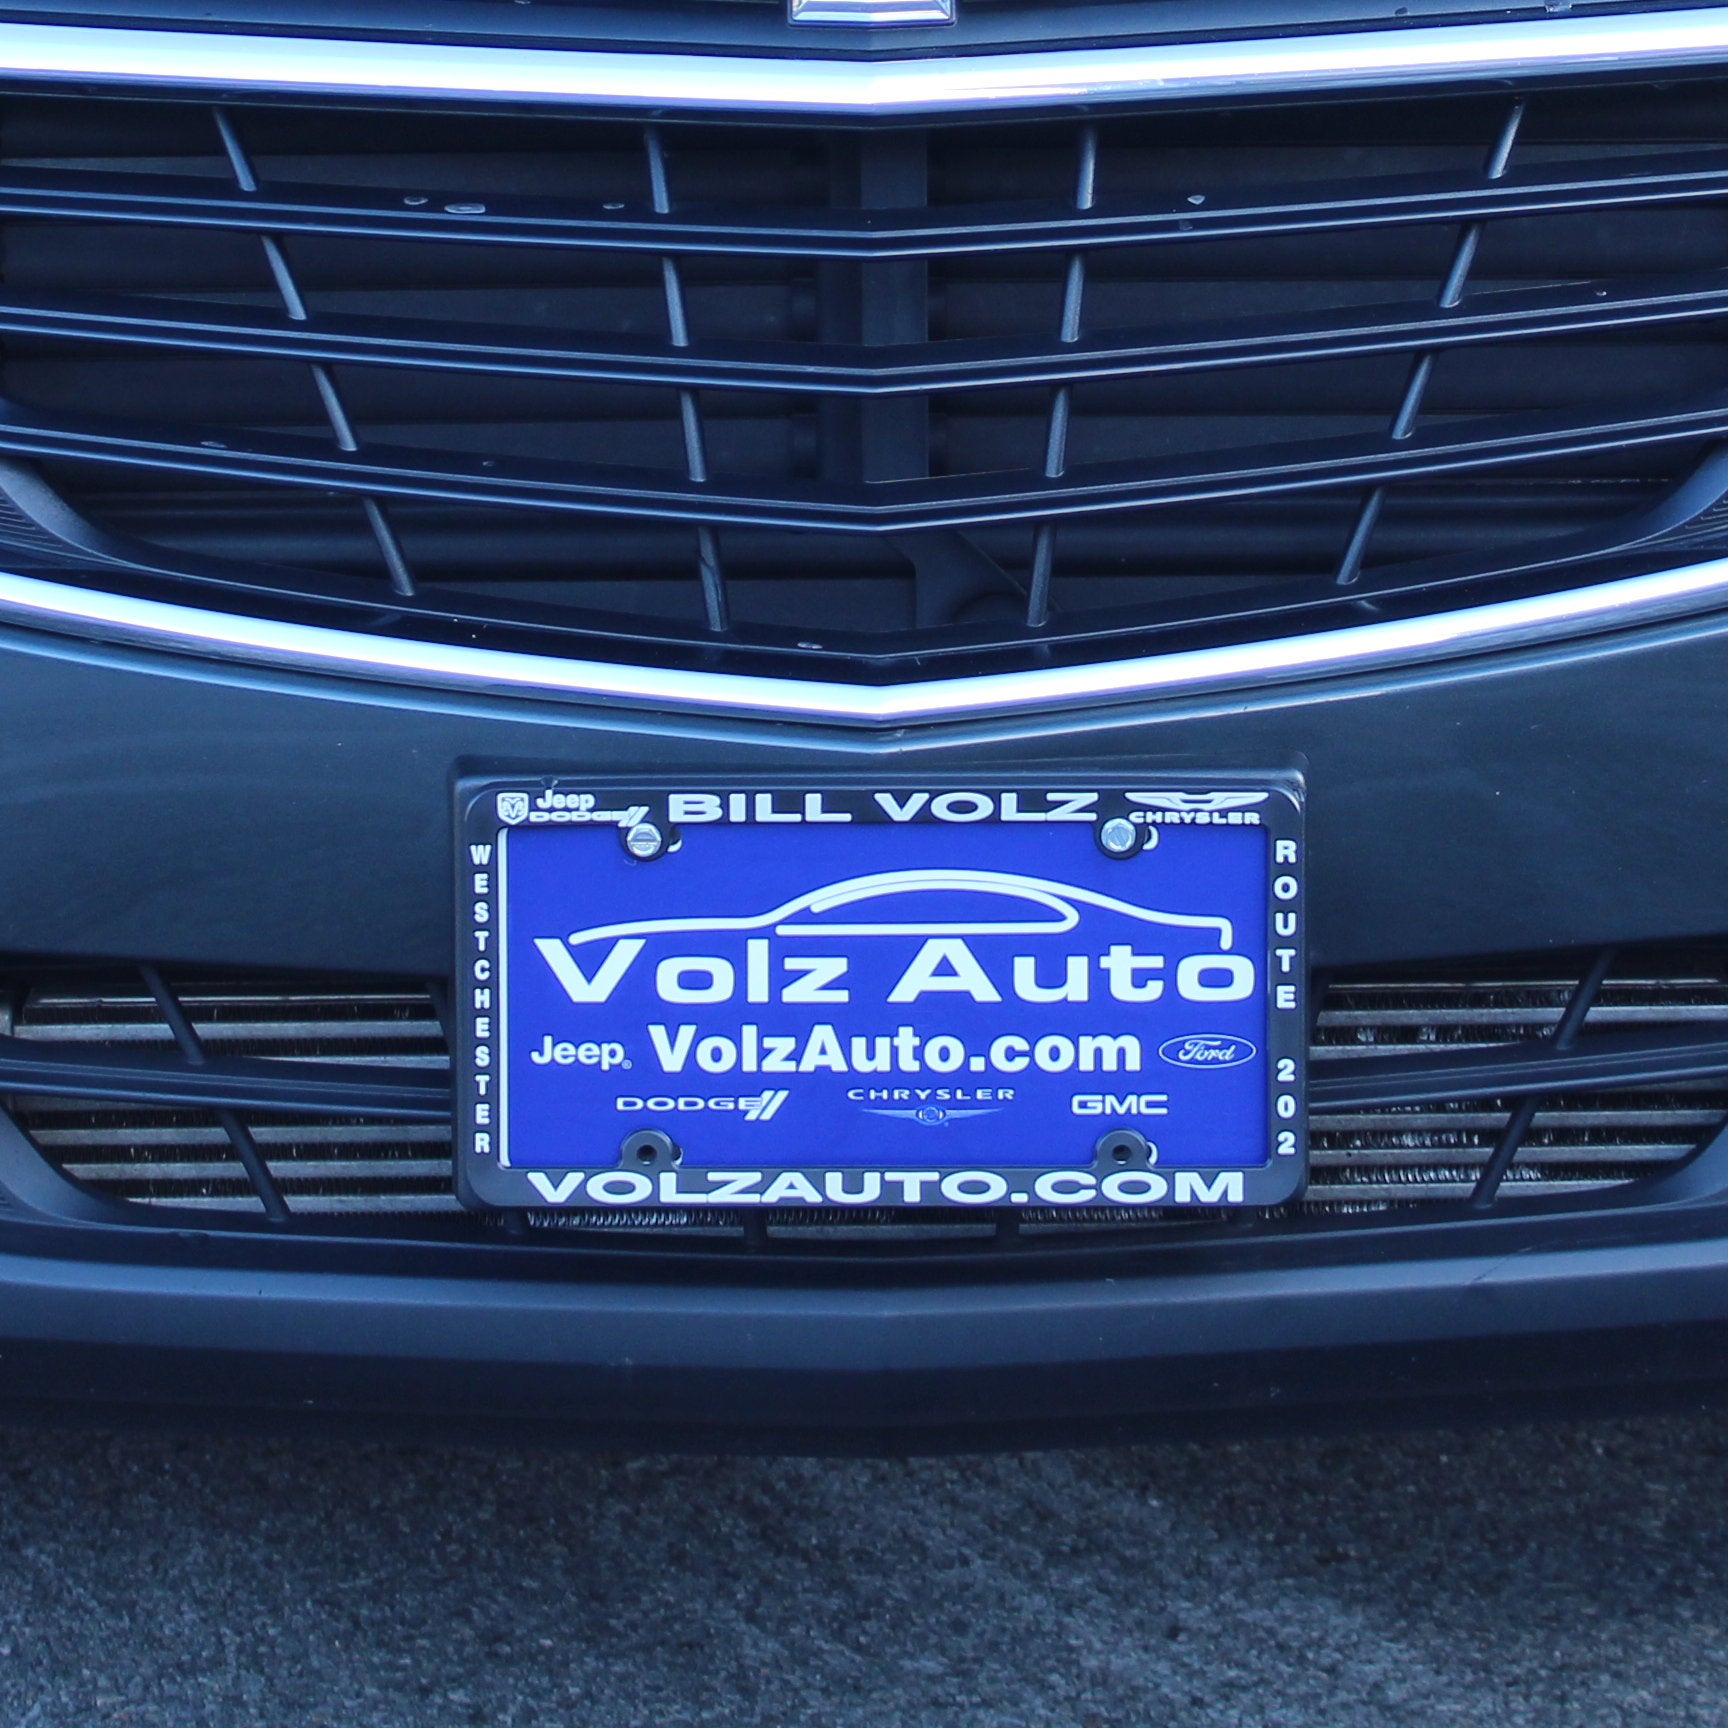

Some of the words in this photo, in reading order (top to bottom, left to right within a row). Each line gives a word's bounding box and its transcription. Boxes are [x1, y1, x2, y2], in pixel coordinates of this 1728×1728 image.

[536, 789, 595, 812] Jeep
[668, 793, 852, 823] BILL
[874, 792, 1099, 822] VOLZ
[1128, 810, 1260, 825] CHRYSLER
[1274, 839, 1299, 1010] ROUTE
[533, 936, 850, 1004] Volz
[886, 936, 1256, 1004] Auto
[470, 843, 492, 1155] WESTCHESTER
[647, 1024, 1141, 1073] VolzAuto.com
[1177, 1037, 1235, 1062] Ford
[847, 1088, 1015, 1100] CHRYSLER
[1071, 1094, 1168, 1115] GMC
[1276, 1058, 1297, 1156] 202
[527, 1171, 1244, 1204] VOLZAUTO.COM
